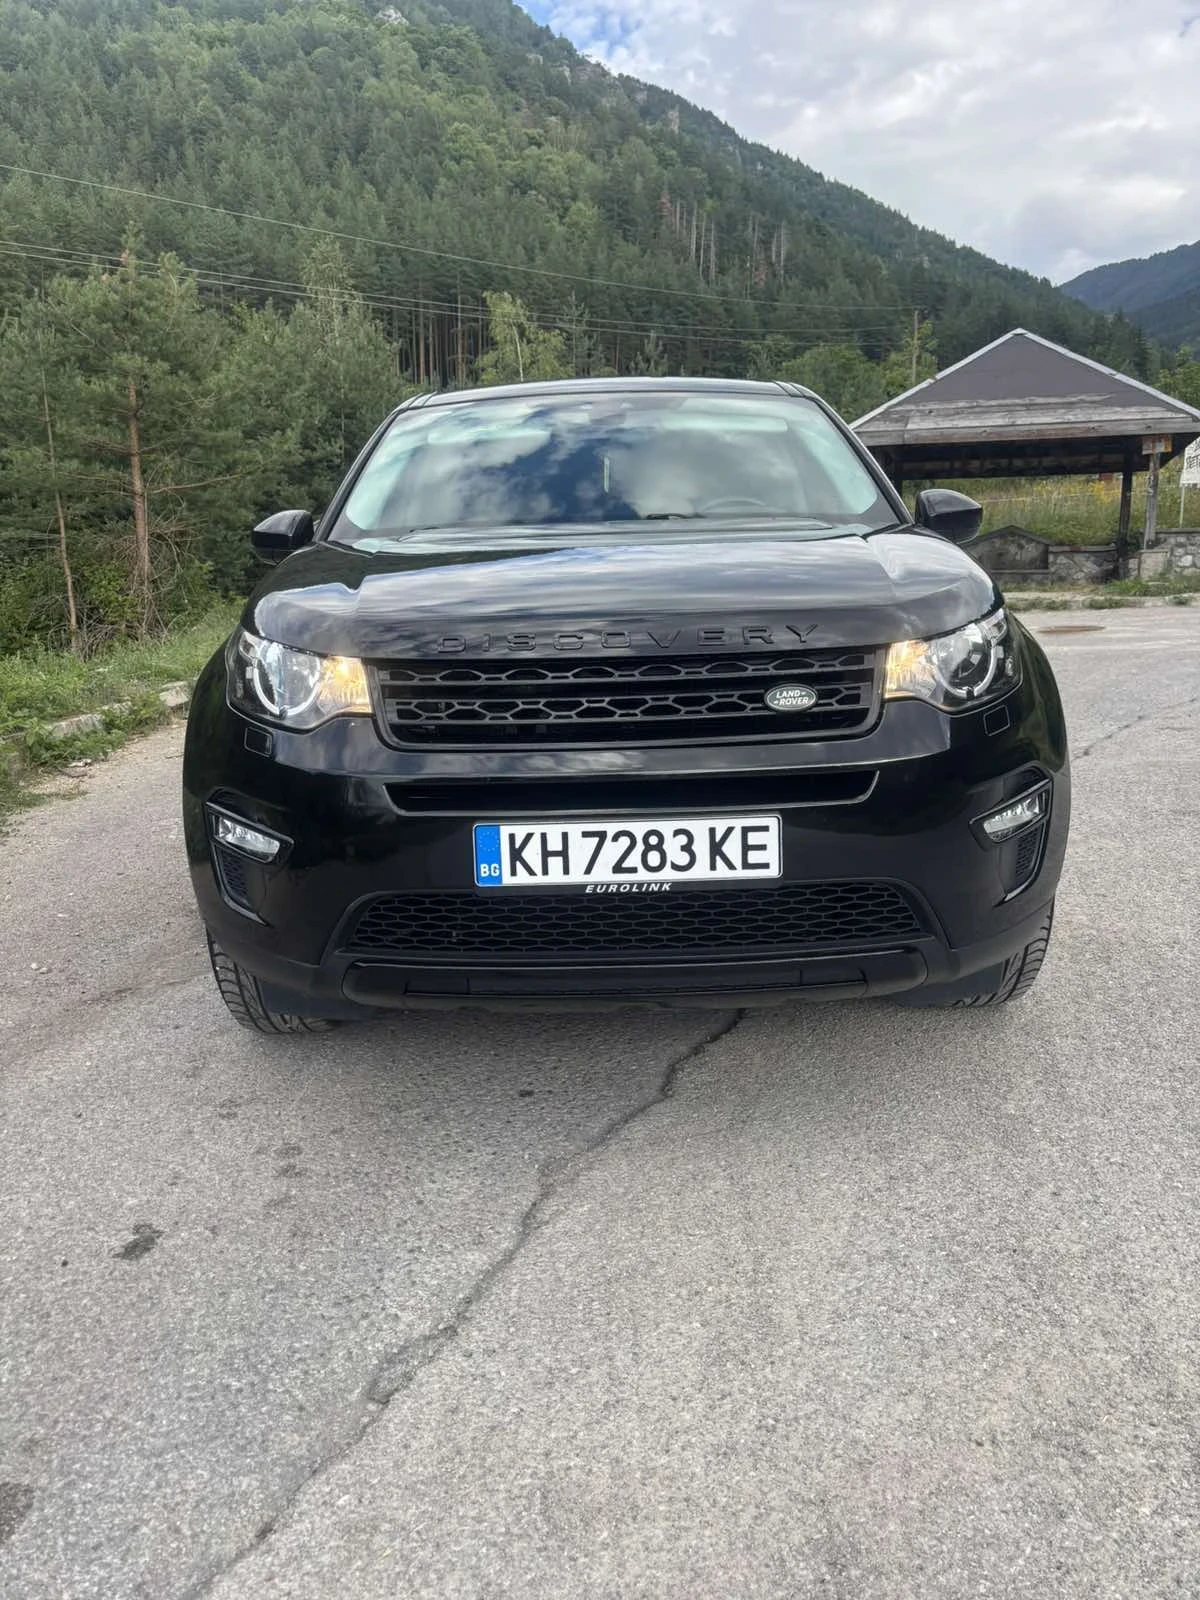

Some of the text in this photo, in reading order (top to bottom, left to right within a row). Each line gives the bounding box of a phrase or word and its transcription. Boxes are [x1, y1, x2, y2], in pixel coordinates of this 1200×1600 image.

[436, 623, 819, 654] DISCOVERY
[779, 697, 809, 706] ROVER
[508, 824, 771, 877] KH 7283 KE
[480, 863, 500, 877] BG
[585, 882, 672, 893] EUROLINK
